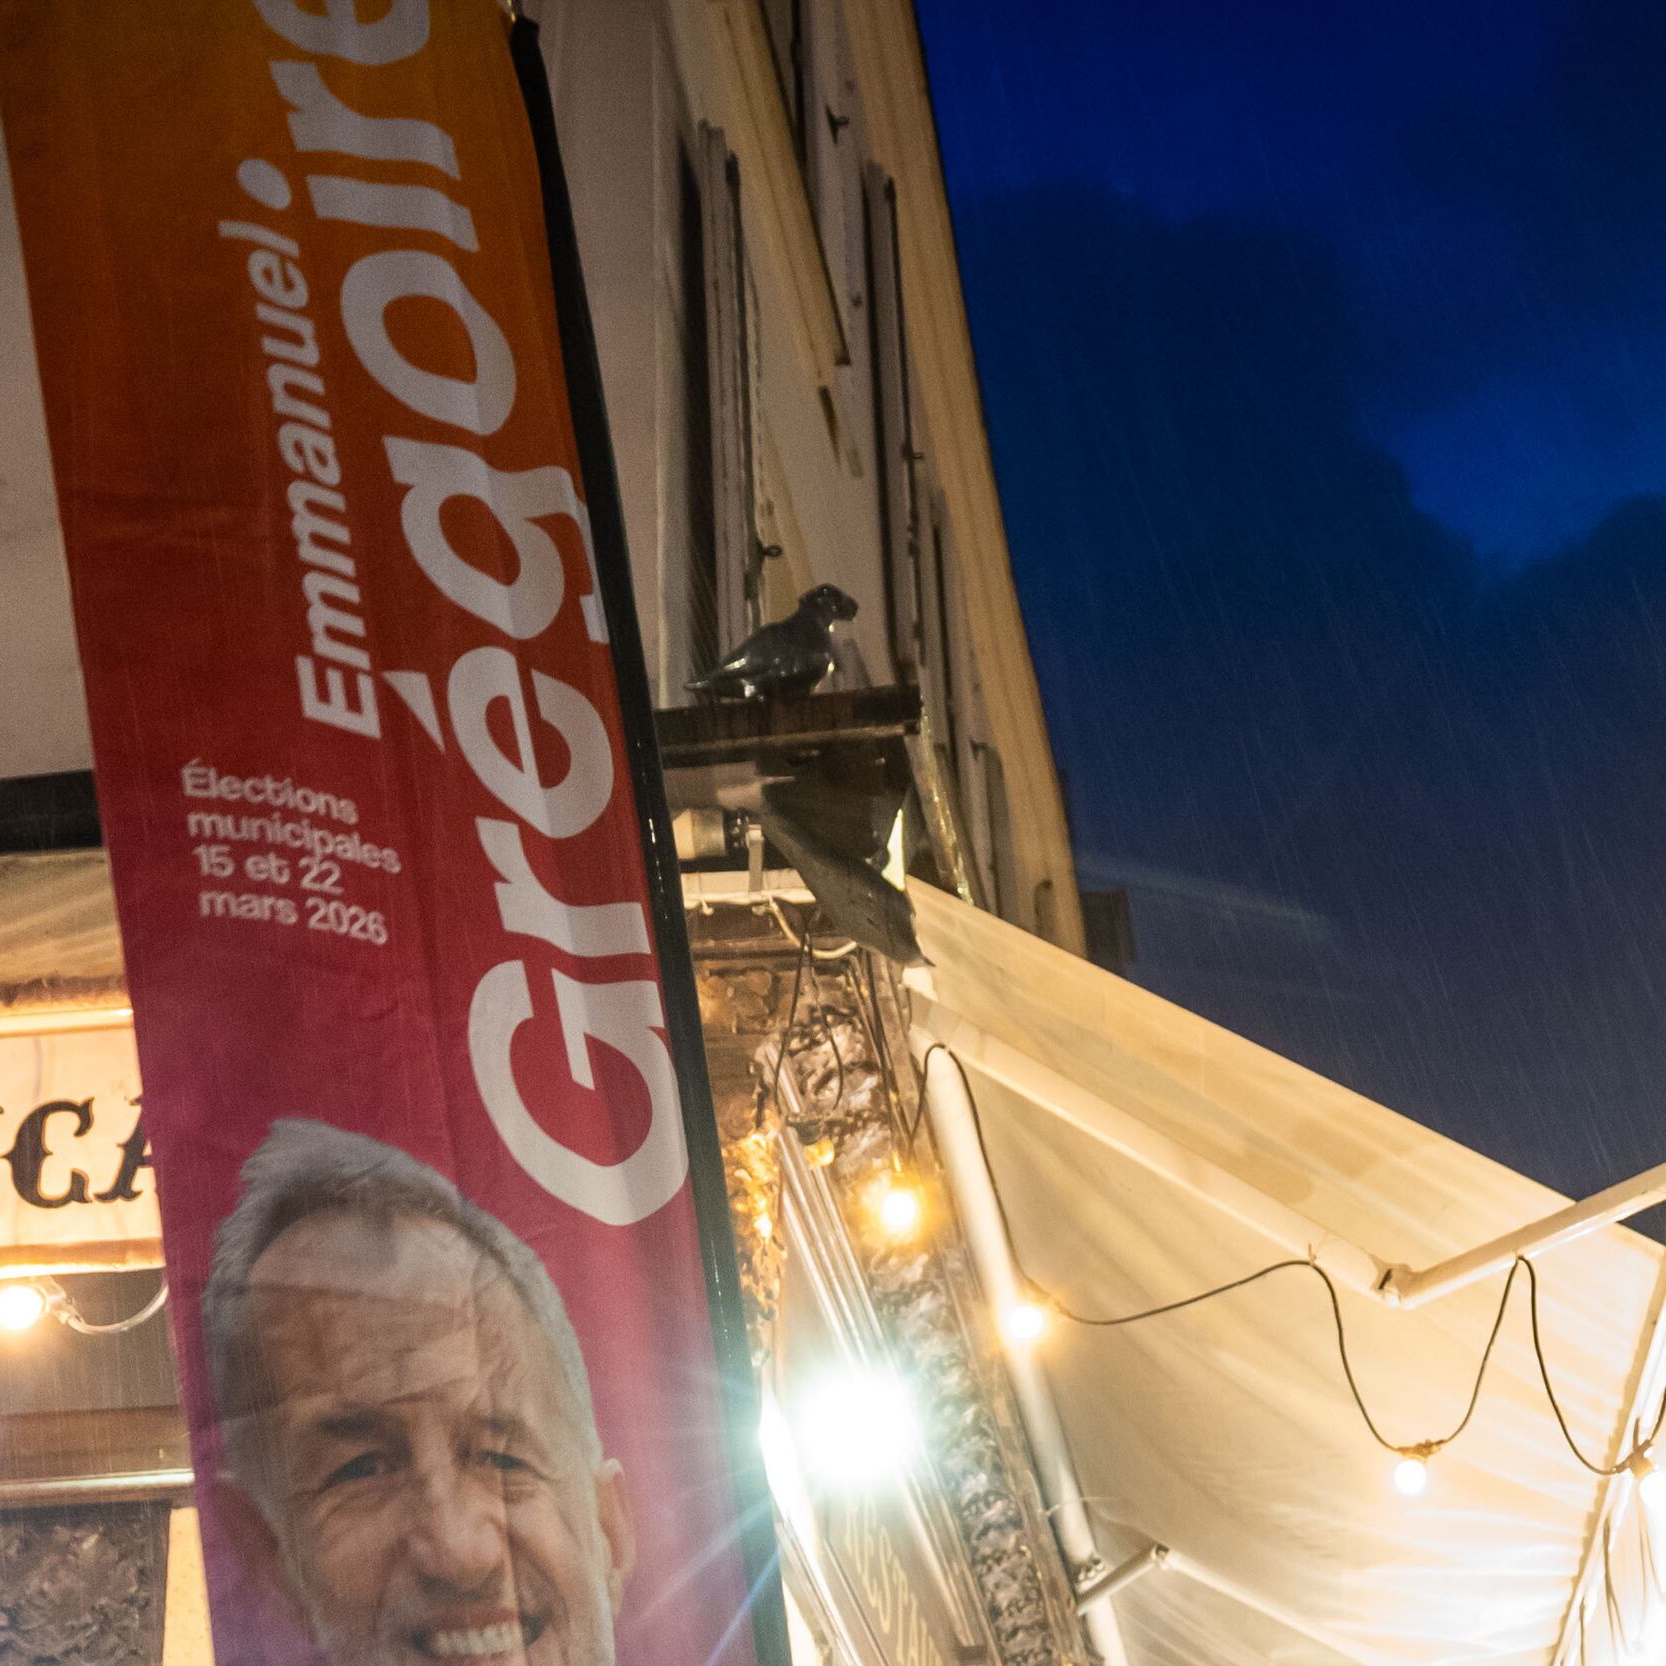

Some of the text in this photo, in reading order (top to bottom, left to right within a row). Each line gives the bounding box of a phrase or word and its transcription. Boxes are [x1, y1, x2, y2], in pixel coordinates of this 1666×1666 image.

[218, 221, 381, 739] Emmanuel
[181, 756, 359, 825] Élections
[187, 811, 402, 874] municipales
[193, 844, 345, 894] 15 et 22
[198, 890, 389, 946] mars 2026
